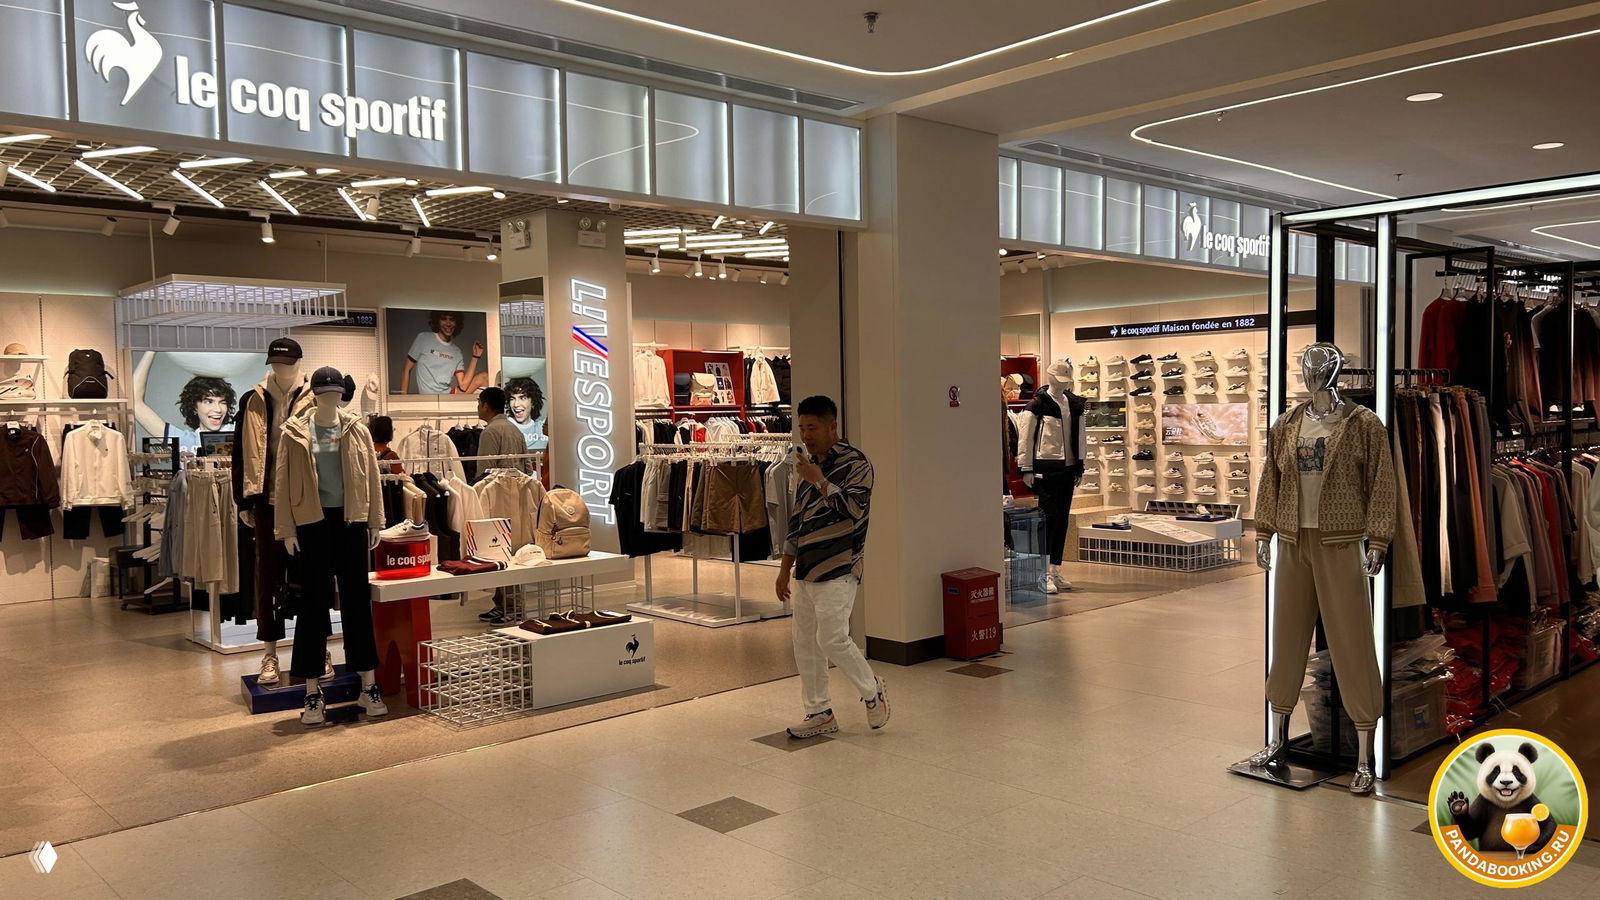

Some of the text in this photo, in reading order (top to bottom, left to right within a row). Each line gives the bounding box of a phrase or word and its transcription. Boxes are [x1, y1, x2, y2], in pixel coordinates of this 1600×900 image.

[174, 55, 447, 141] le coq sportif
[1203, 225, 1270, 258] le coq sportif
[356, 315, 373, 325] 1882
[1161, 323, 1190, 333] Maison
[1191, 321, 1219, 330] fondée
[1234, 318, 1255, 327] 1882
[386, 554, 396, 566] le
[397, 556, 416, 567] coq
